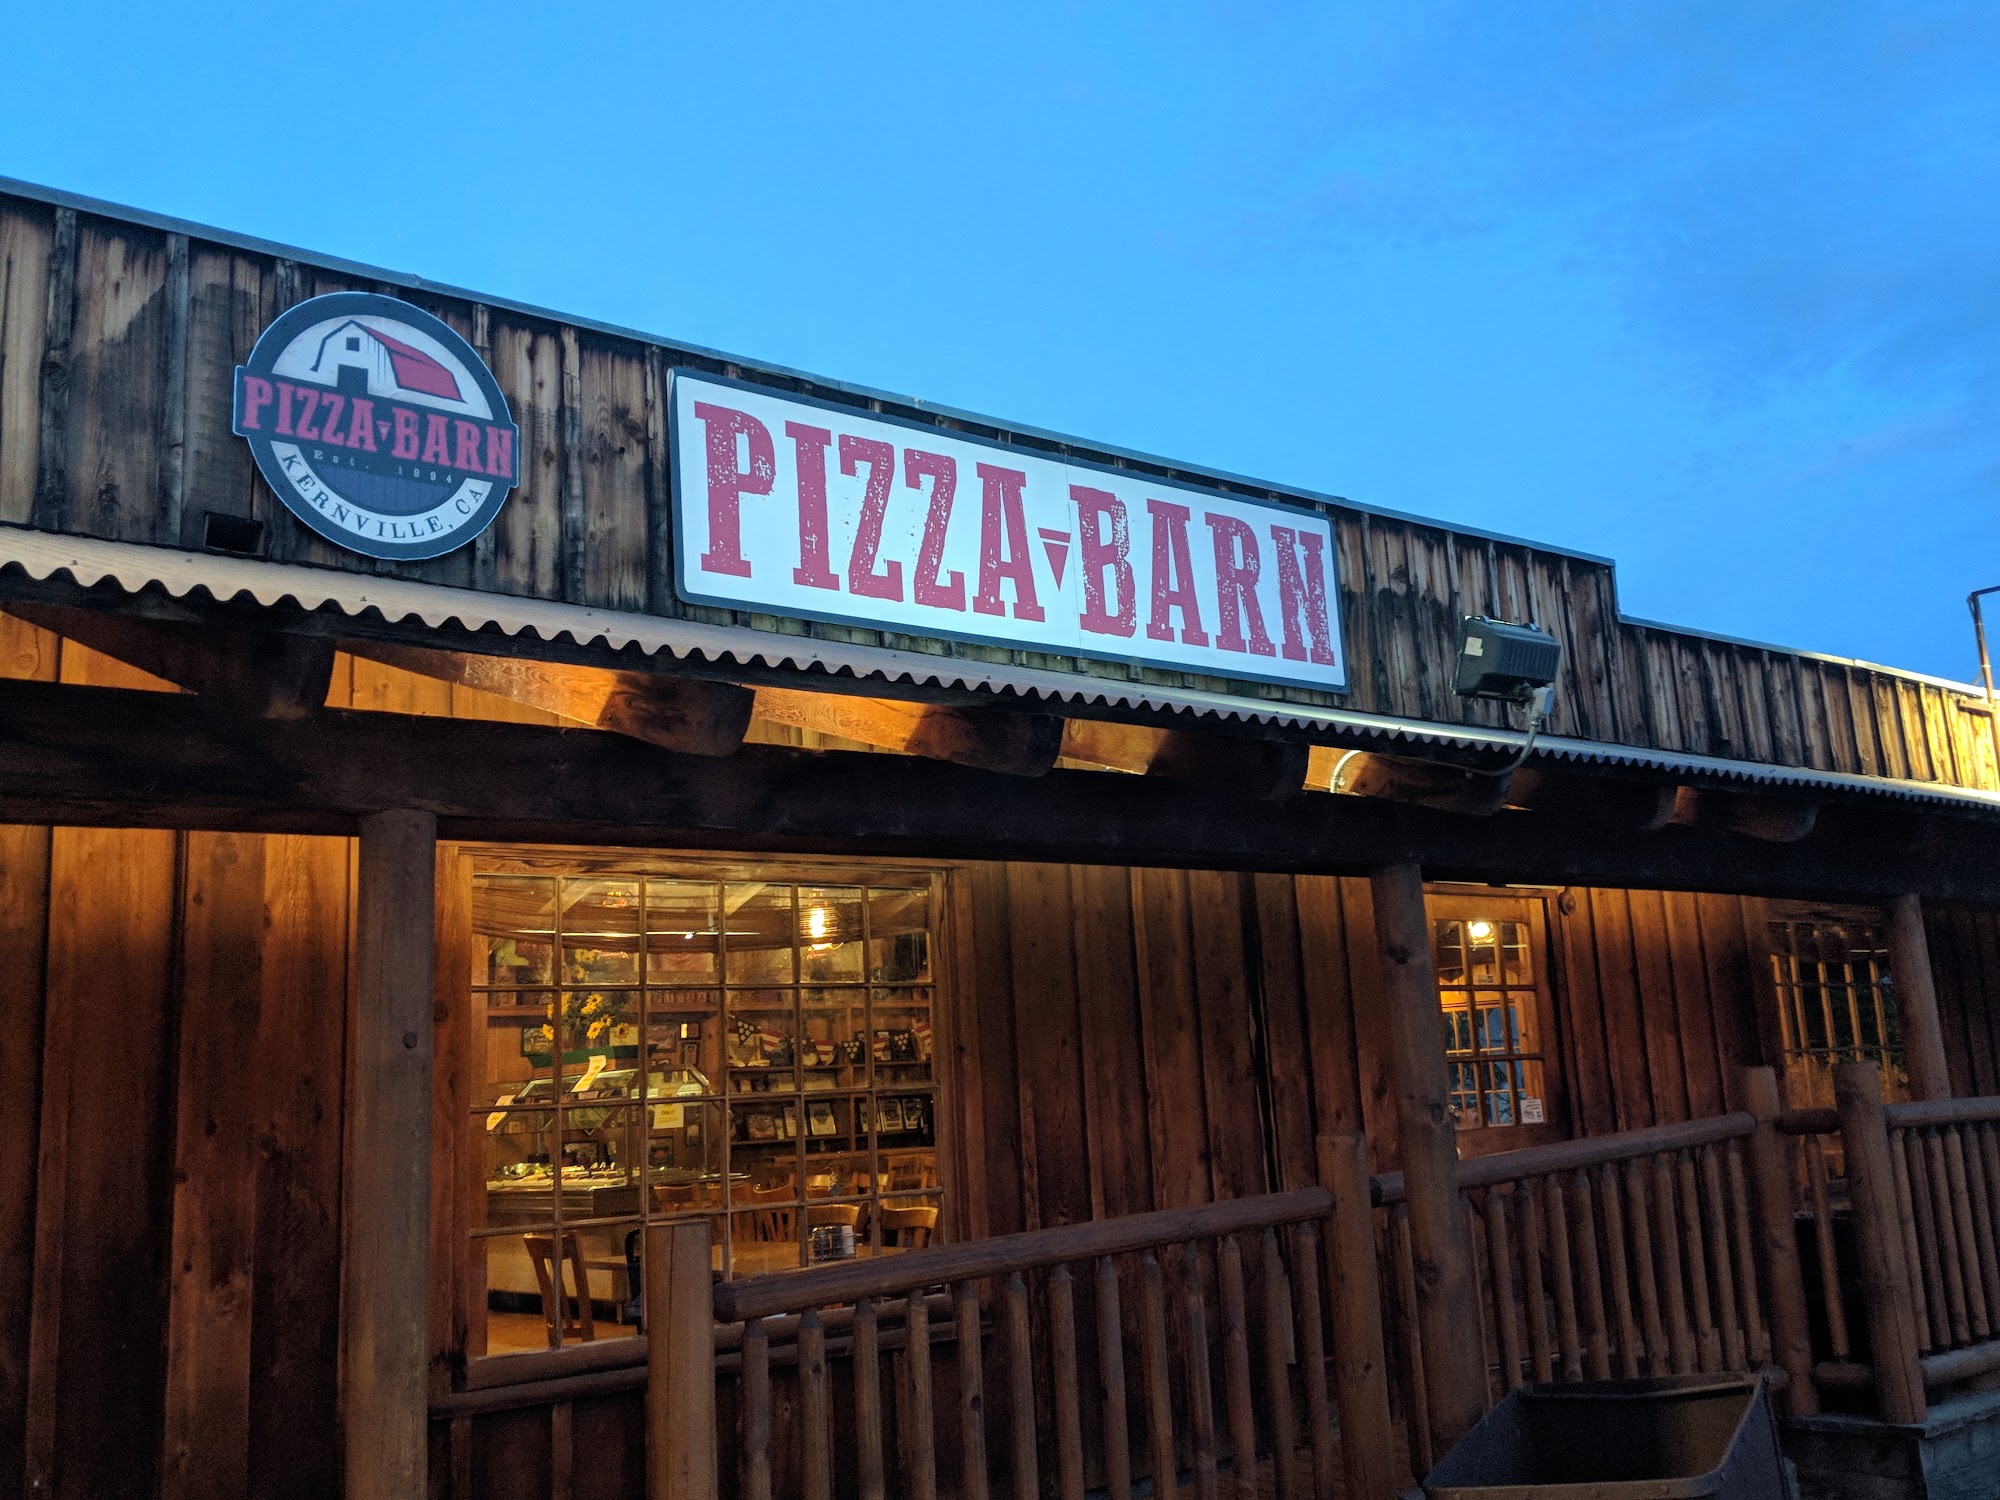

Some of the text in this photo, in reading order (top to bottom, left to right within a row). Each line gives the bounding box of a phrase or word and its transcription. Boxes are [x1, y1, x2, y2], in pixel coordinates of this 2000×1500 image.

[242, 375, 513, 479] PIZZA BARN
[314, 450, 452, 483] Est. 1994
[281, 453, 484, 539] KERNVILLE, CA
[694, 401, 1335, 667] PIZZA BARN
